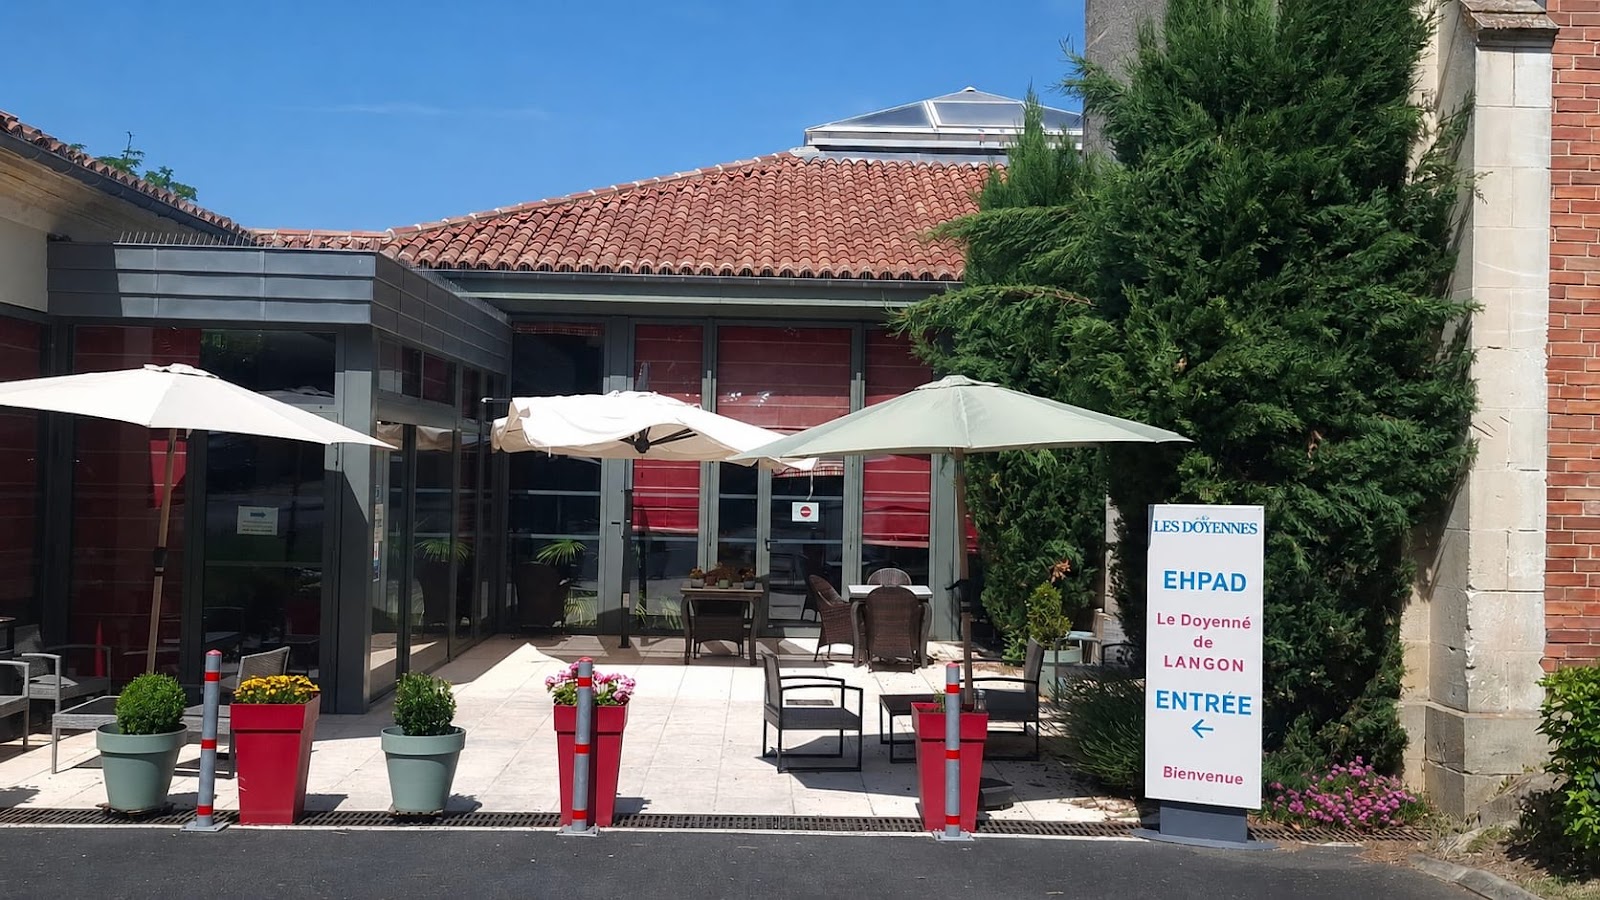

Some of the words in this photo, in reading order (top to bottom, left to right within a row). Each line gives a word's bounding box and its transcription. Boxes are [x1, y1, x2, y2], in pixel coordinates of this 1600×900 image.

[1154, 520, 1180, 533] LES
[1163, 570, 1248, 592] EHPAD
[1157, 613, 1175, 625] Le
[1181, 613, 1251, 630] Doyenné
[1193, 635, 1213, 649] de
[1164, 655, 1244, 672] LANGON
[1156, 690, 1252, 715] ENTRÉE
[1163, 766, 1244, 785] Bienvenue
